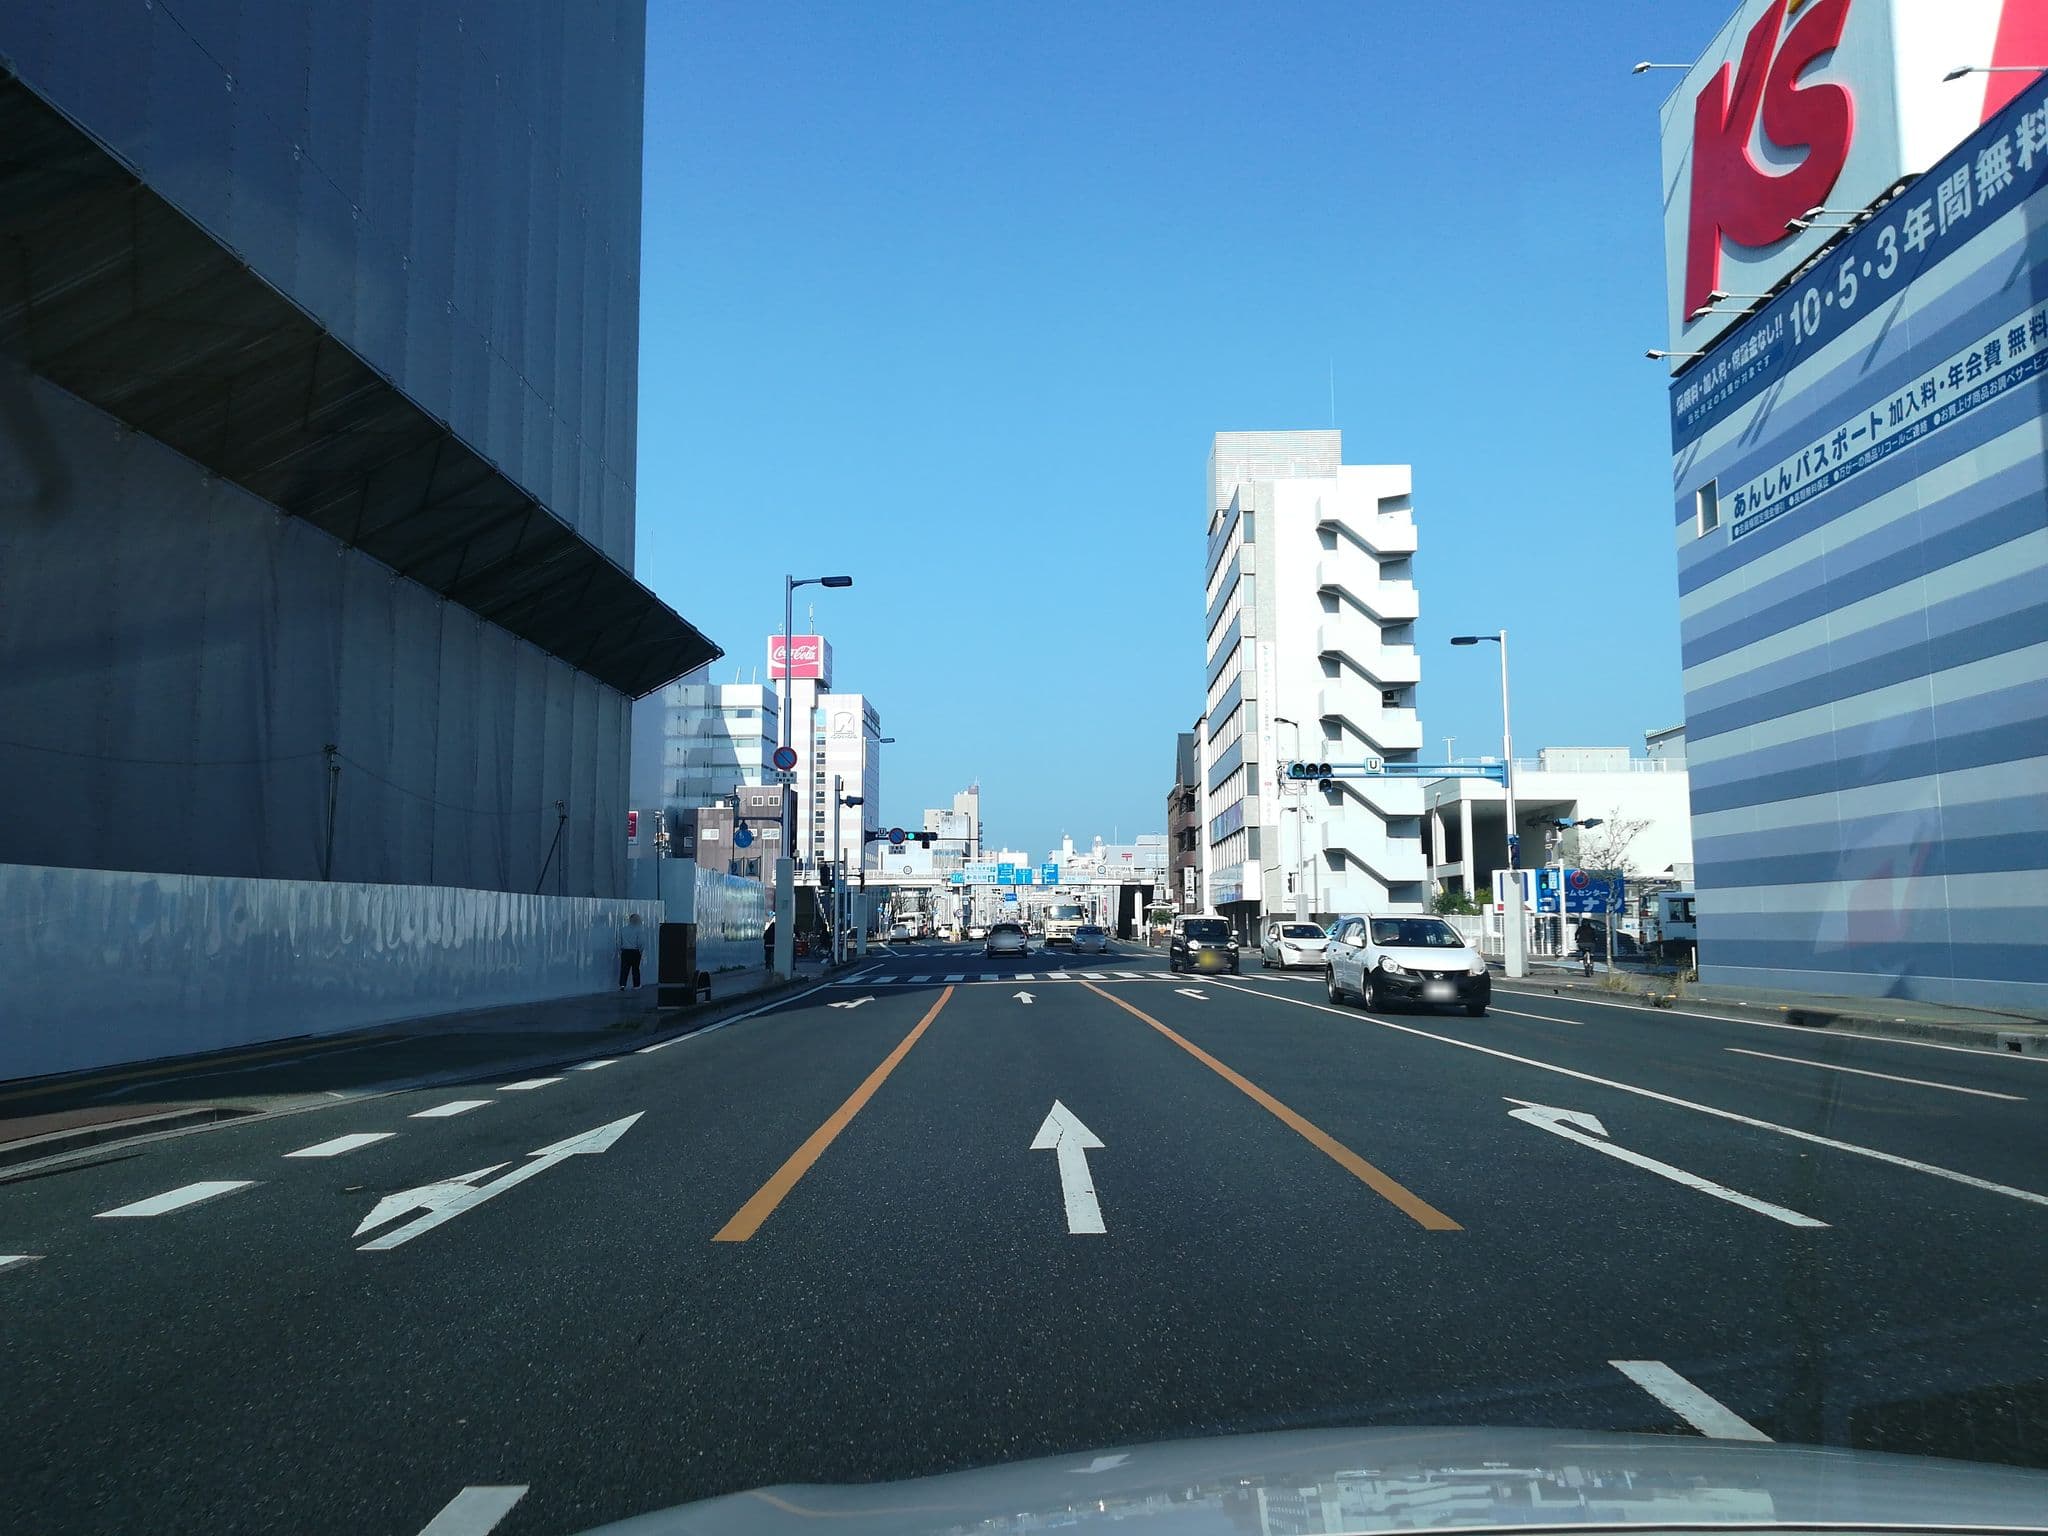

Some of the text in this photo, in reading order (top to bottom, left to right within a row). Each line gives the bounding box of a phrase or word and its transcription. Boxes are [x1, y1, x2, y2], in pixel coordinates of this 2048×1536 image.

[1733, 411, 1883, 519] あんしんパスポート
[2008, 309, 2048, 358] 無料
[773, 645, 818, 660] Coa-Cola
